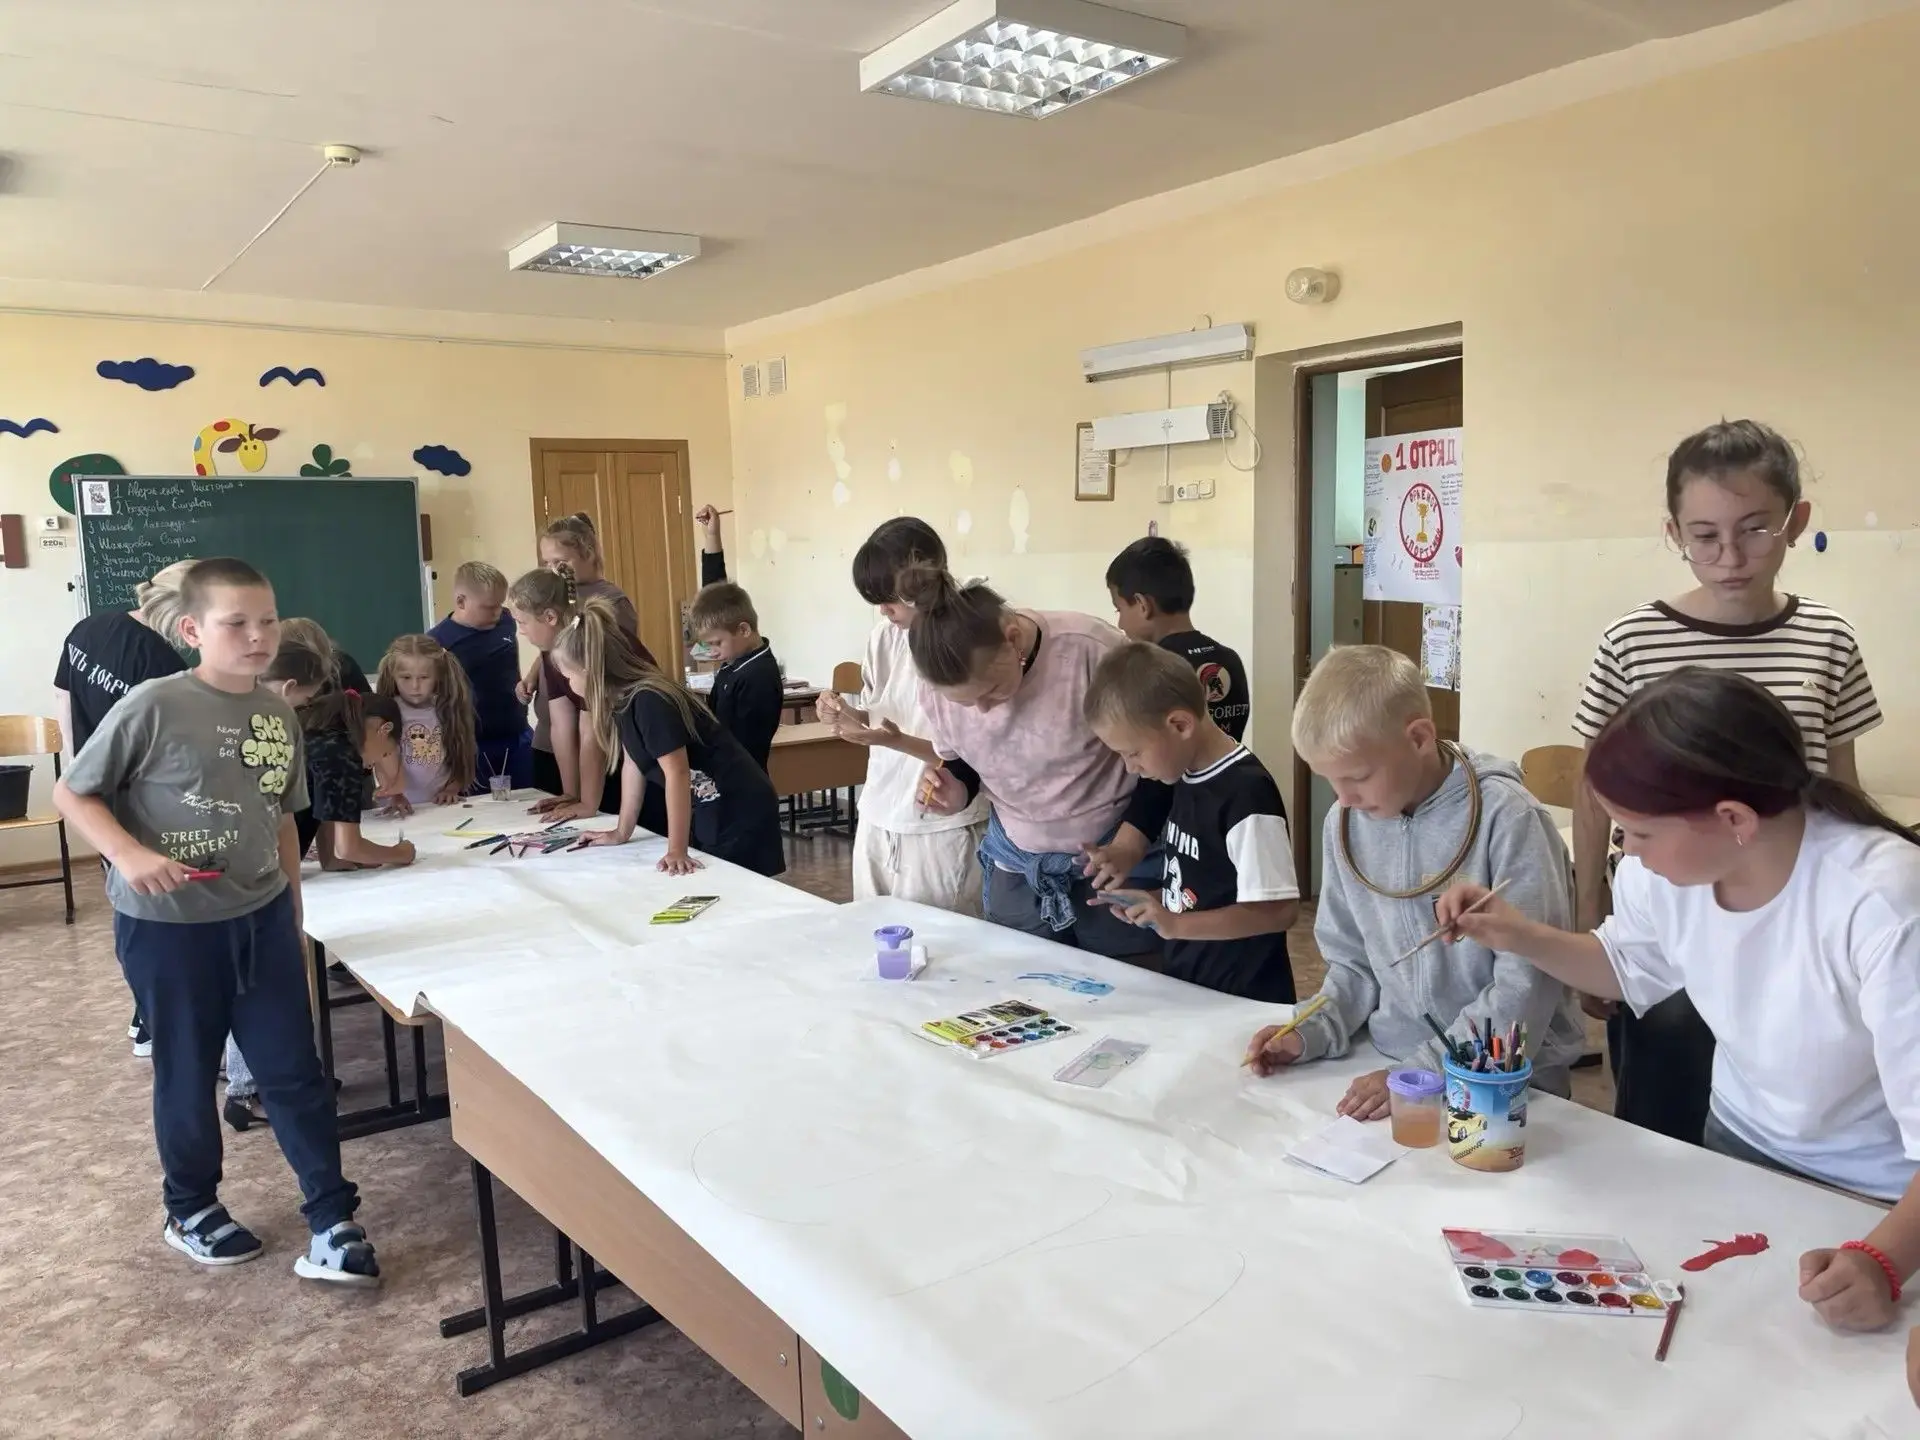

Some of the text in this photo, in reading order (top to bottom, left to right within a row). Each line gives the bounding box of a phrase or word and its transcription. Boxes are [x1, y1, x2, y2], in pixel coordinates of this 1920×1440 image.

[1395, 443, 1407, 471] 1
[1409, 438, 1457, 469] ОТРЯД
[160, 829, 211, 845] STREET
